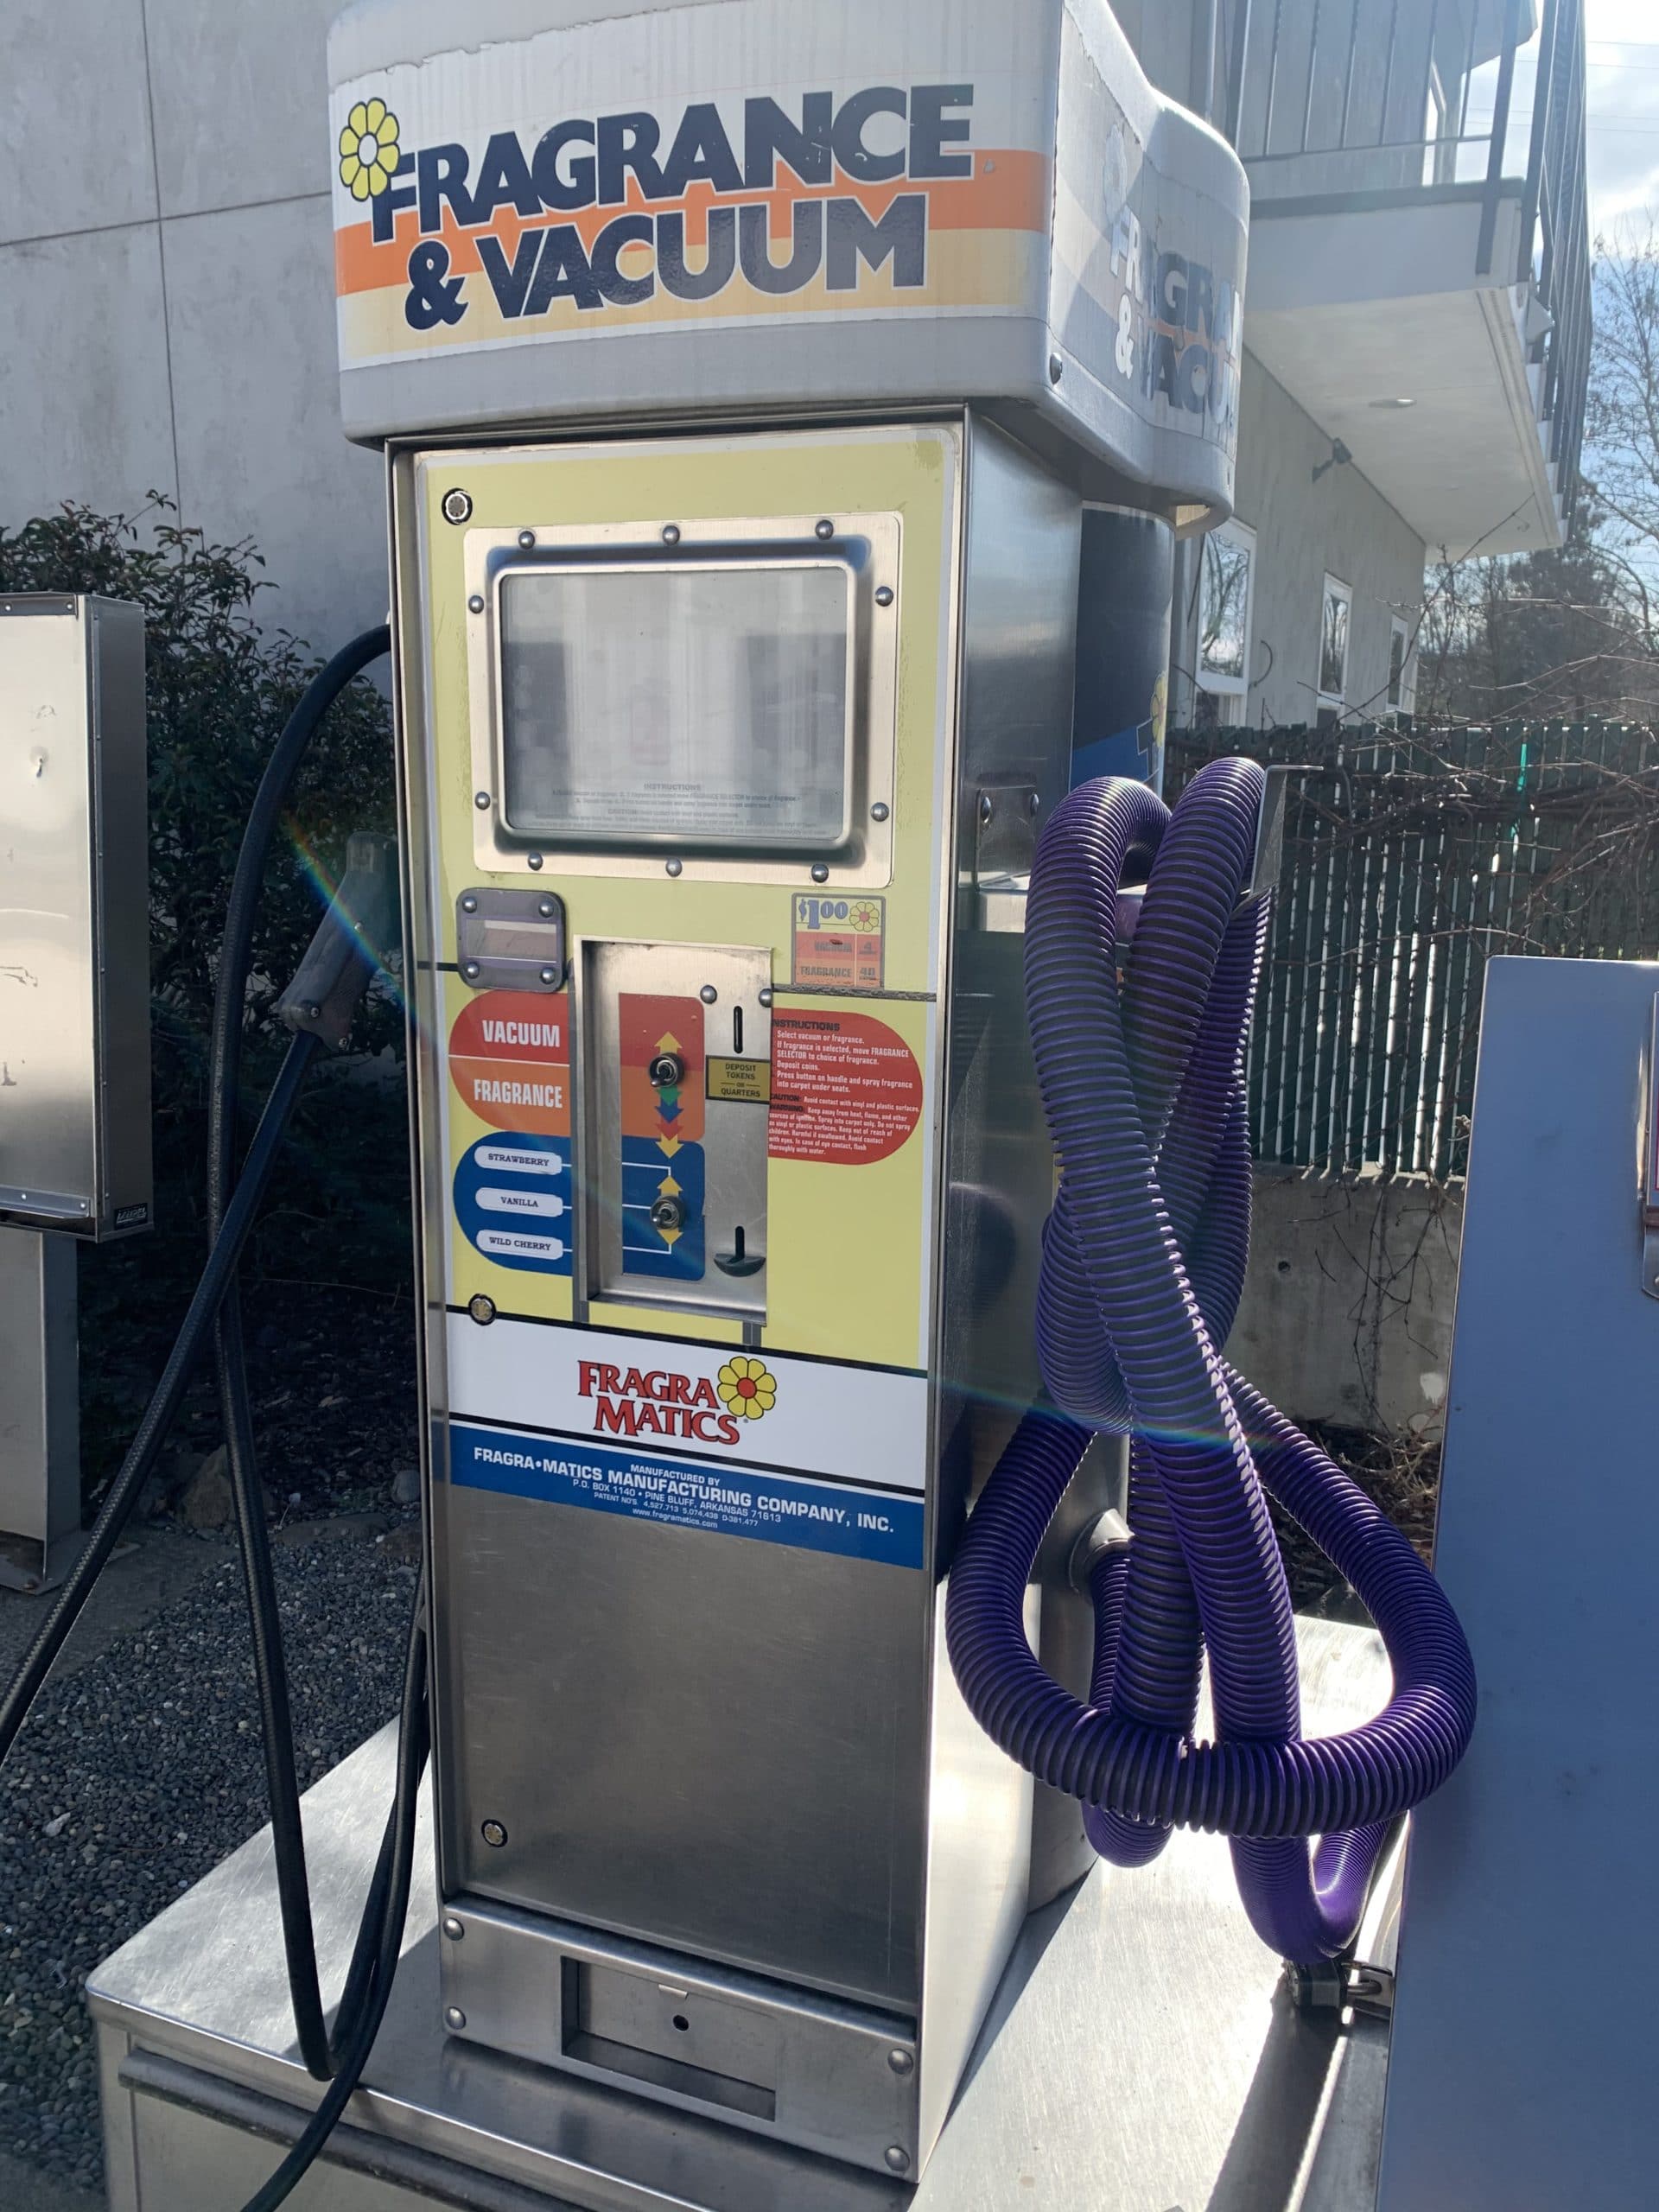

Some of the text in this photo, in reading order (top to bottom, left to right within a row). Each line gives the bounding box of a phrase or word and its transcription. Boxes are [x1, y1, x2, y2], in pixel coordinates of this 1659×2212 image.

[373, 84, 975, 244] FRAGRANCE
[404, 194, 927, 332] & VACUUM
[800, 966, 852, 977] FRAGRANCE
[773, 1020, 840, 1031] NSTRUCTIONS
[482, 1020, 561, 1048] VACUUM
[777, 1030, 797, 1039] Select
[831, 1033, 865, 1045] fragrance.
[777, 1040, 783, 1049] If
[783, 1041, 814, 1052] fragrance
[871, 1047, 909, 1058] FRAGRANCE
[777, 1050, 807, 1059] SELECTOR
[816, 1052, 837, 1062] choice
[838, 1054, 846, 1063] of
[846, 1055, 880, 1065] fragrance.
[777, 1060, 800, 1070] Deposit
[725, 1063, 757, 1072] DEPOSIT
[726, 1071, 756, 1080] TOKENS
[777, 1070, 795, 1079] Press
[796, 1071, 817, 1081] button
[826, 1074, 849, 1084] handle
[862, 1078, 880, 1088] spray
[881, 1078, 913, 1089] fragrance
[721, 1088, 761, 1097] QUARTERS
[777, 1079, 789, 1088] into
[790, 1082, 810, 1091] carpet
[811, 1083, 830, 1091] under
[474, 1078, 563, 1109] FRAGRANCE
[804, 1096, 818, 1104] Avoid
[807, 1106, 821, 1115] Keep
[817, 1116, 833, 1124] Spray
[895, 1123, 911, 1132] spray
[863, 1136, 884, 1145] contact
[487, 1153, 550, 1167] STRAWBERRY
[499, 1196, 540, 1209] VANILLA
[488, 1236, 552, 1252] WILD CHERRY
[577, 1359, 721, 1410] FRAGRA
[593, 1394, 741, 1446] MATICS
[630, 1464, 721, 1487] MANUFACTURED BY
[572, 1478, 782, 1523] P.O. BOX 1140 PINE BLUFF, ARKANSAS 71613
[594, 1491, 620, 1503] PATENT
[607, 1470, 752, 1508] MANUFACTURING
[756, 1496, 851, 1529] COMPANY,
[857, 1512, 894, 1534] INC.
[632, 1507, 718, 1529] www.fragramatics.com
